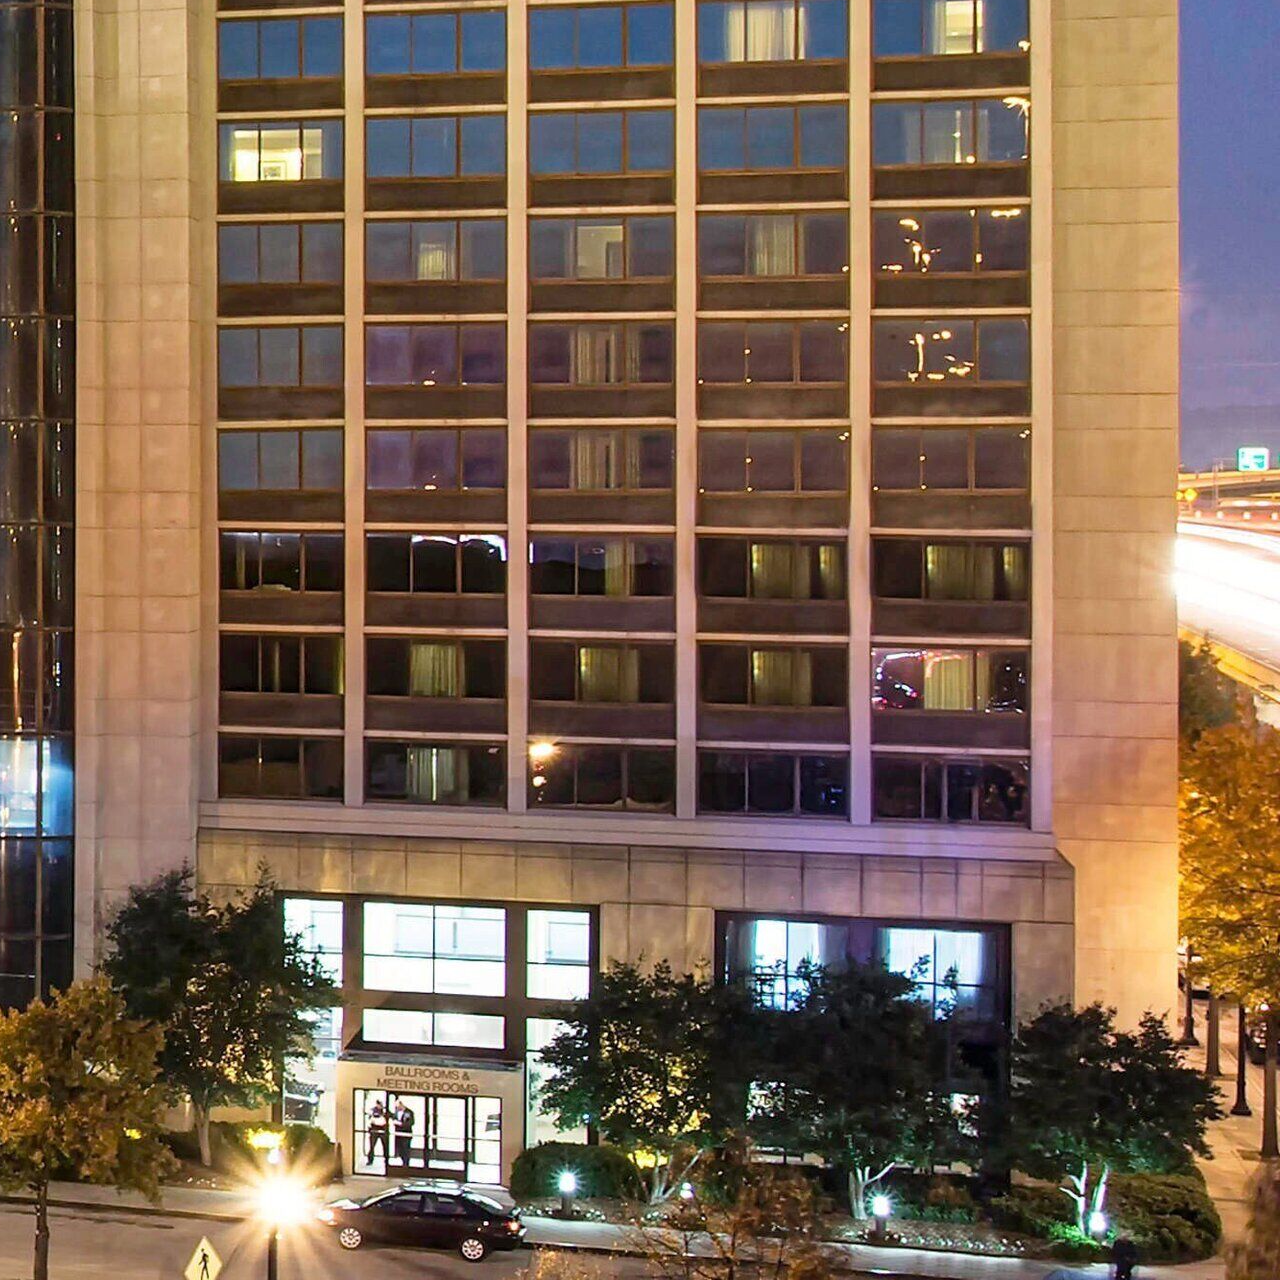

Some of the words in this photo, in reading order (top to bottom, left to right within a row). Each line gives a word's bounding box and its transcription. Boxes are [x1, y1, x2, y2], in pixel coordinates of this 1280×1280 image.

[385, 1066, 459, 1080] BALLROOMS
[462, 1070, 470, 1081] &
[377, 1078, 430, 1091] MEETING
[433, 1082, 479, 1094] ROOMS
